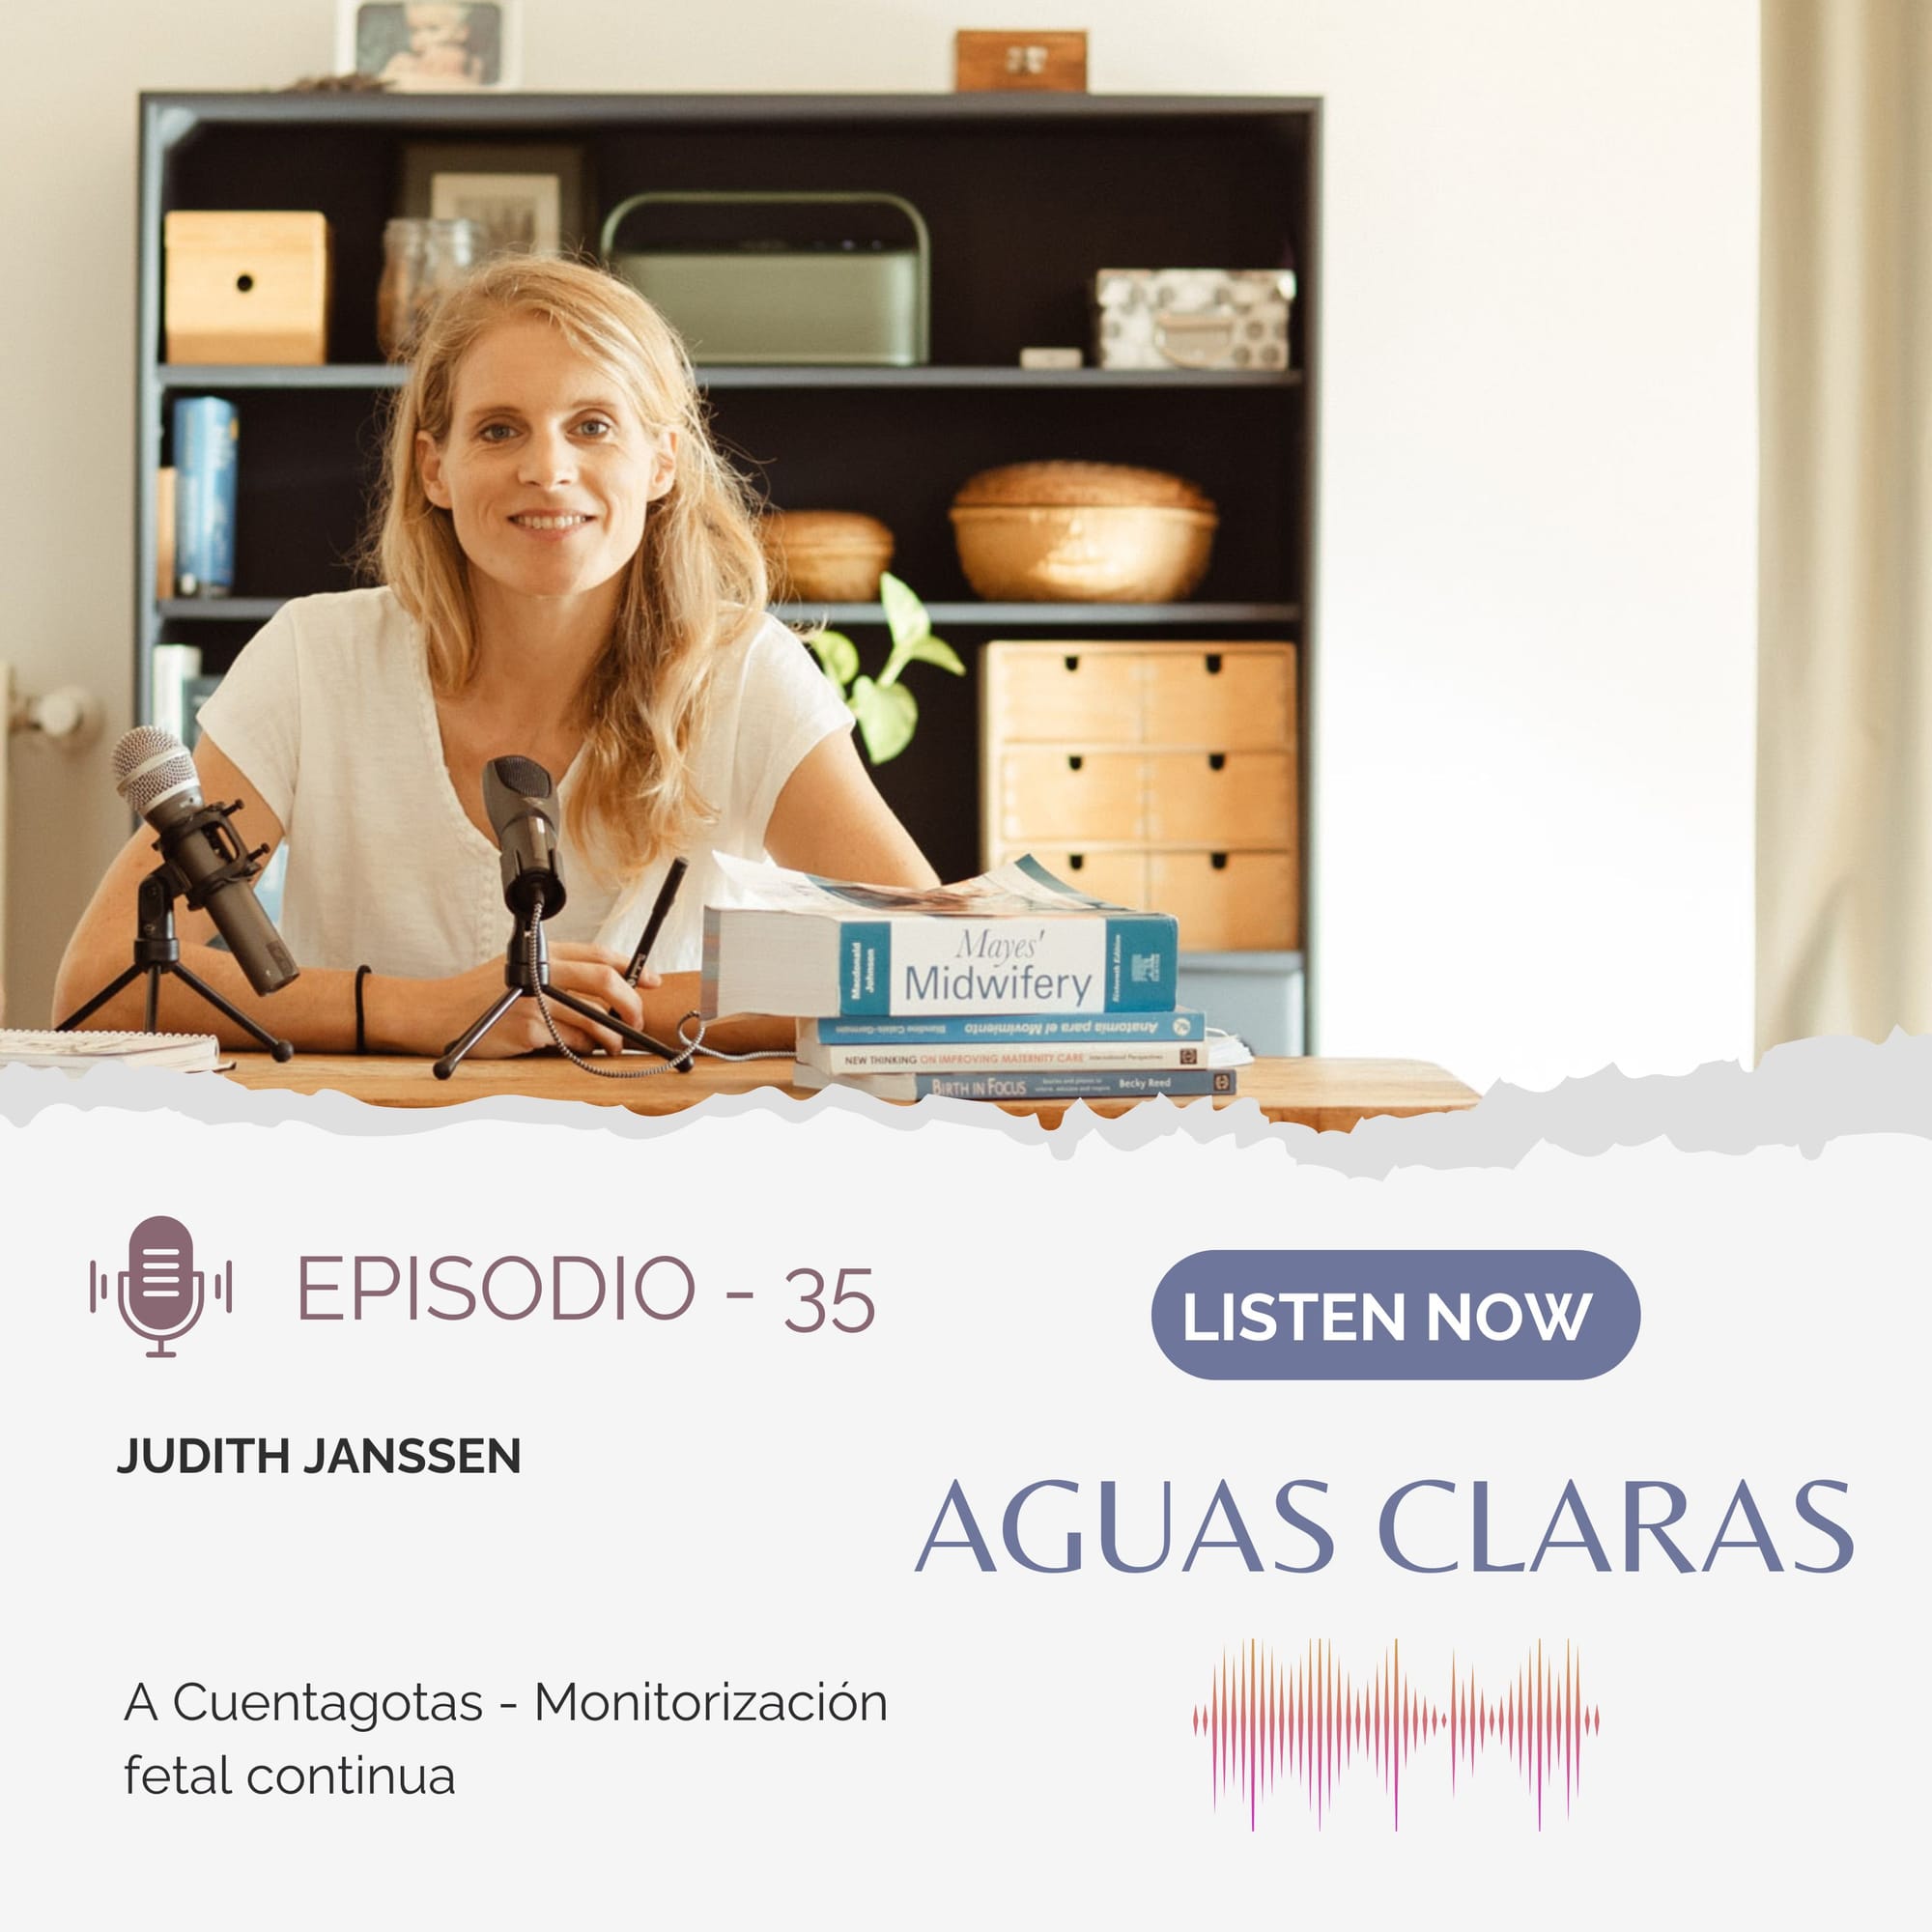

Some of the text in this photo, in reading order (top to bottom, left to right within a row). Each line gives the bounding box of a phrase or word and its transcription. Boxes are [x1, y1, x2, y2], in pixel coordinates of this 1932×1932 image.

[955, 929, 1044, 968] Mayes'
[866, 949, 875, 993] Johnson
[905, 965, 1093, 1008] Midwifery
[964, 1023, 1042, 1036] Movimiento
[1046, 1023, 1059, 1034] el
[1062, 1020, 1092, 1033] para
[845, 1053, 1083, 1065] NEW THINKING ON IMPROVING MATERNITY CARE
[973, 1080, 986, 1094] IN
[987, 1077, 1027, 1095] FOCUS
[1119, 1077, 1172, 1090] Becky Reed
